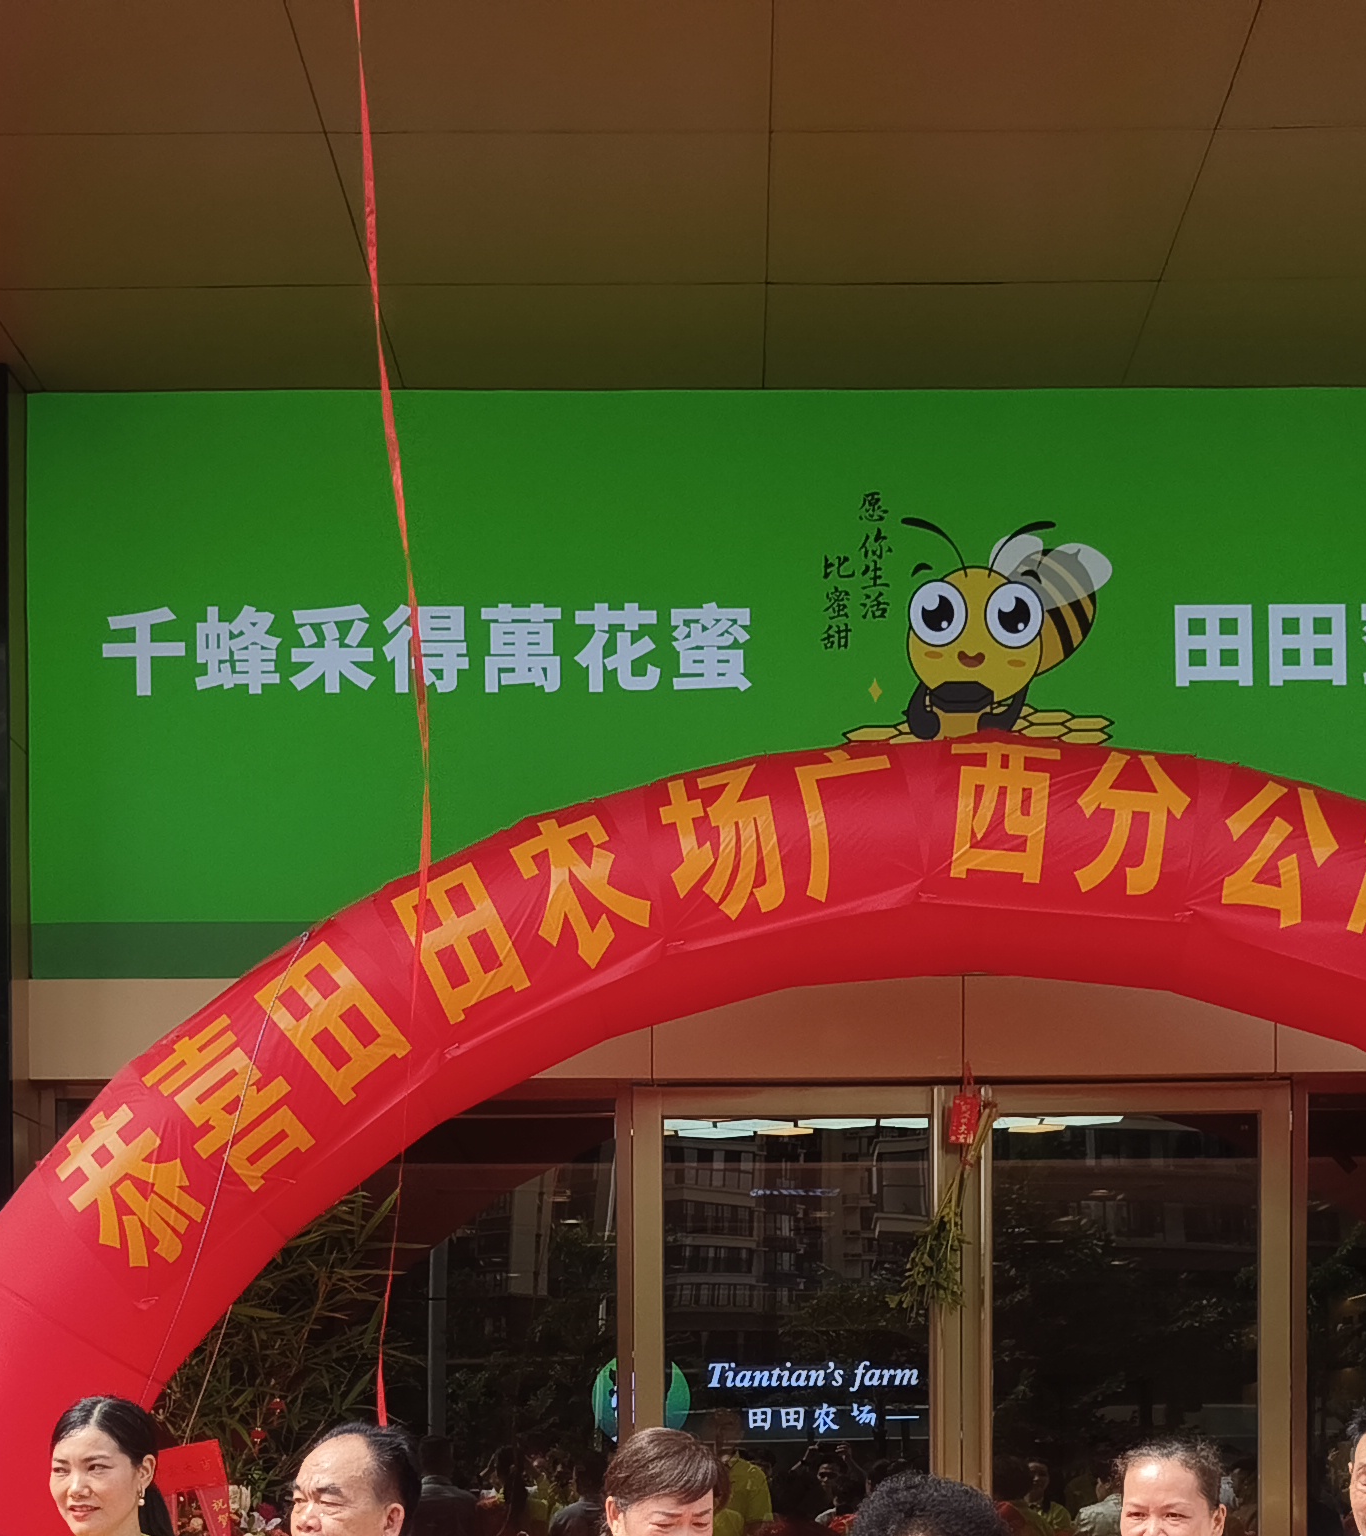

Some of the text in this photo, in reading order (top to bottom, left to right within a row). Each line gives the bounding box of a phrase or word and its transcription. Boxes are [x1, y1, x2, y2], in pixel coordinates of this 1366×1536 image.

[820, 553, 856, 652] 比蜜甜
[857, 490, 894, 622] 愿你生活
[101, 602, 753, 696] 千蜂采得萬花蜜
[707, 1361, 920, 1392] Tiantian's farm
[747, 1403, 878, 1434] 田田农场
